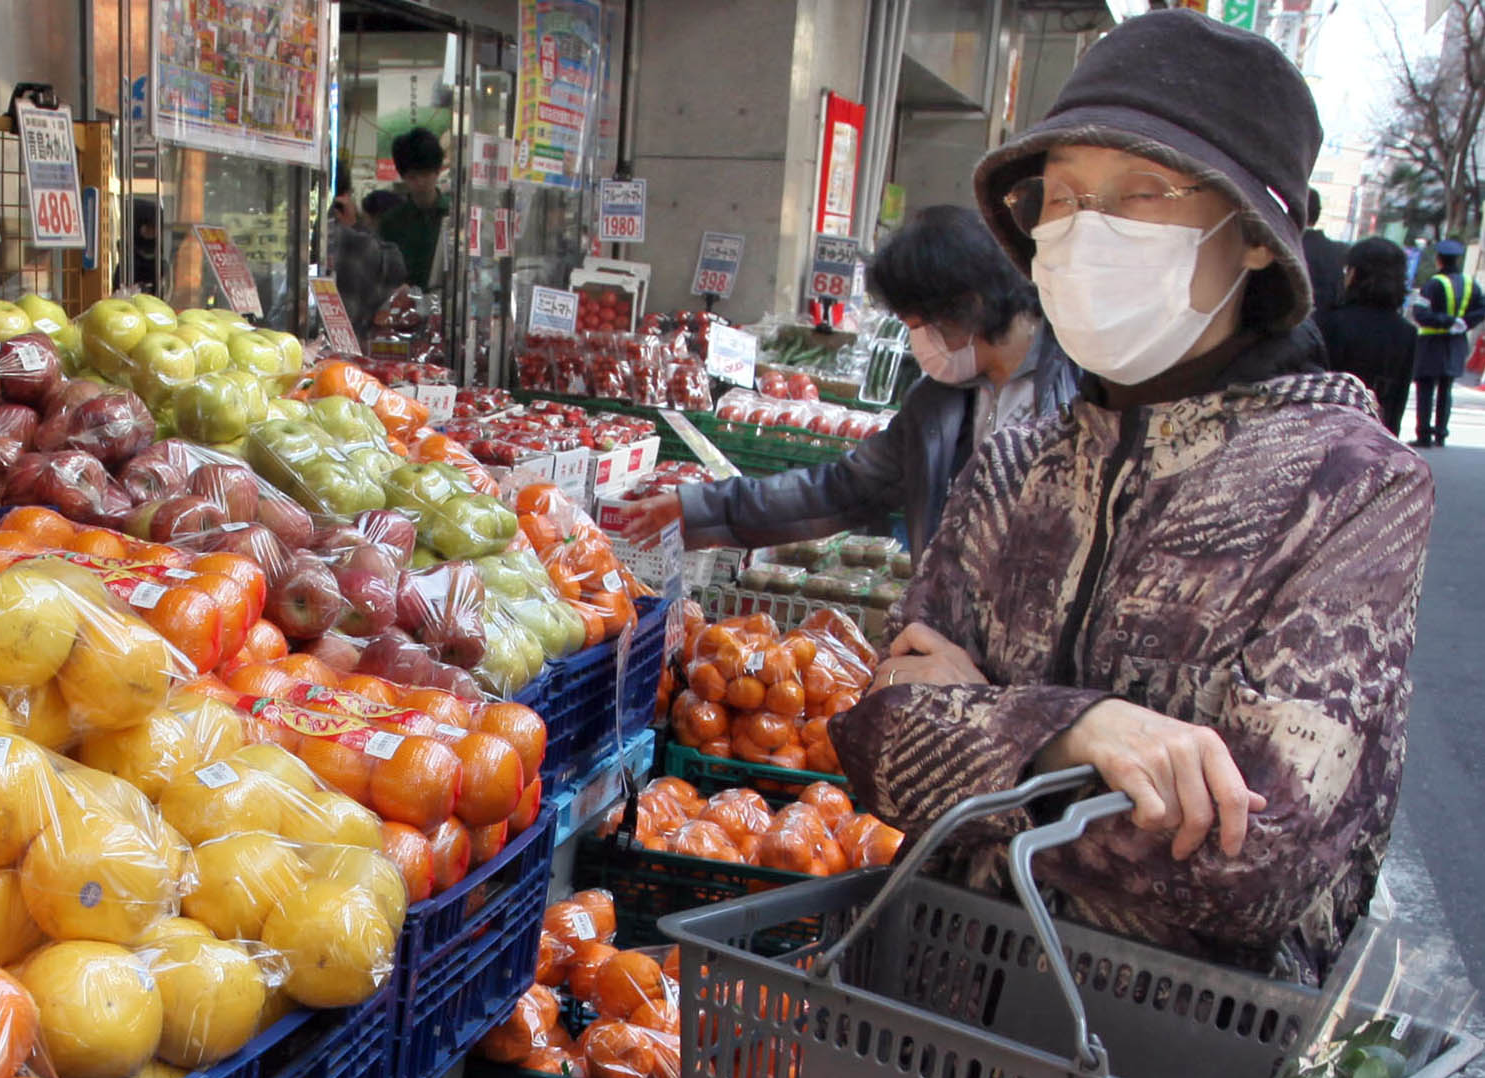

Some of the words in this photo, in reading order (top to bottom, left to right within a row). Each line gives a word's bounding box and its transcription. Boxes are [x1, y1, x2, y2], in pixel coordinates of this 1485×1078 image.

[37, 191, 73, 234] 480
[604, 216, 636, 237] 1980
[698, 270, 727, 292] 398
[813, 273, 845, 295] 68
